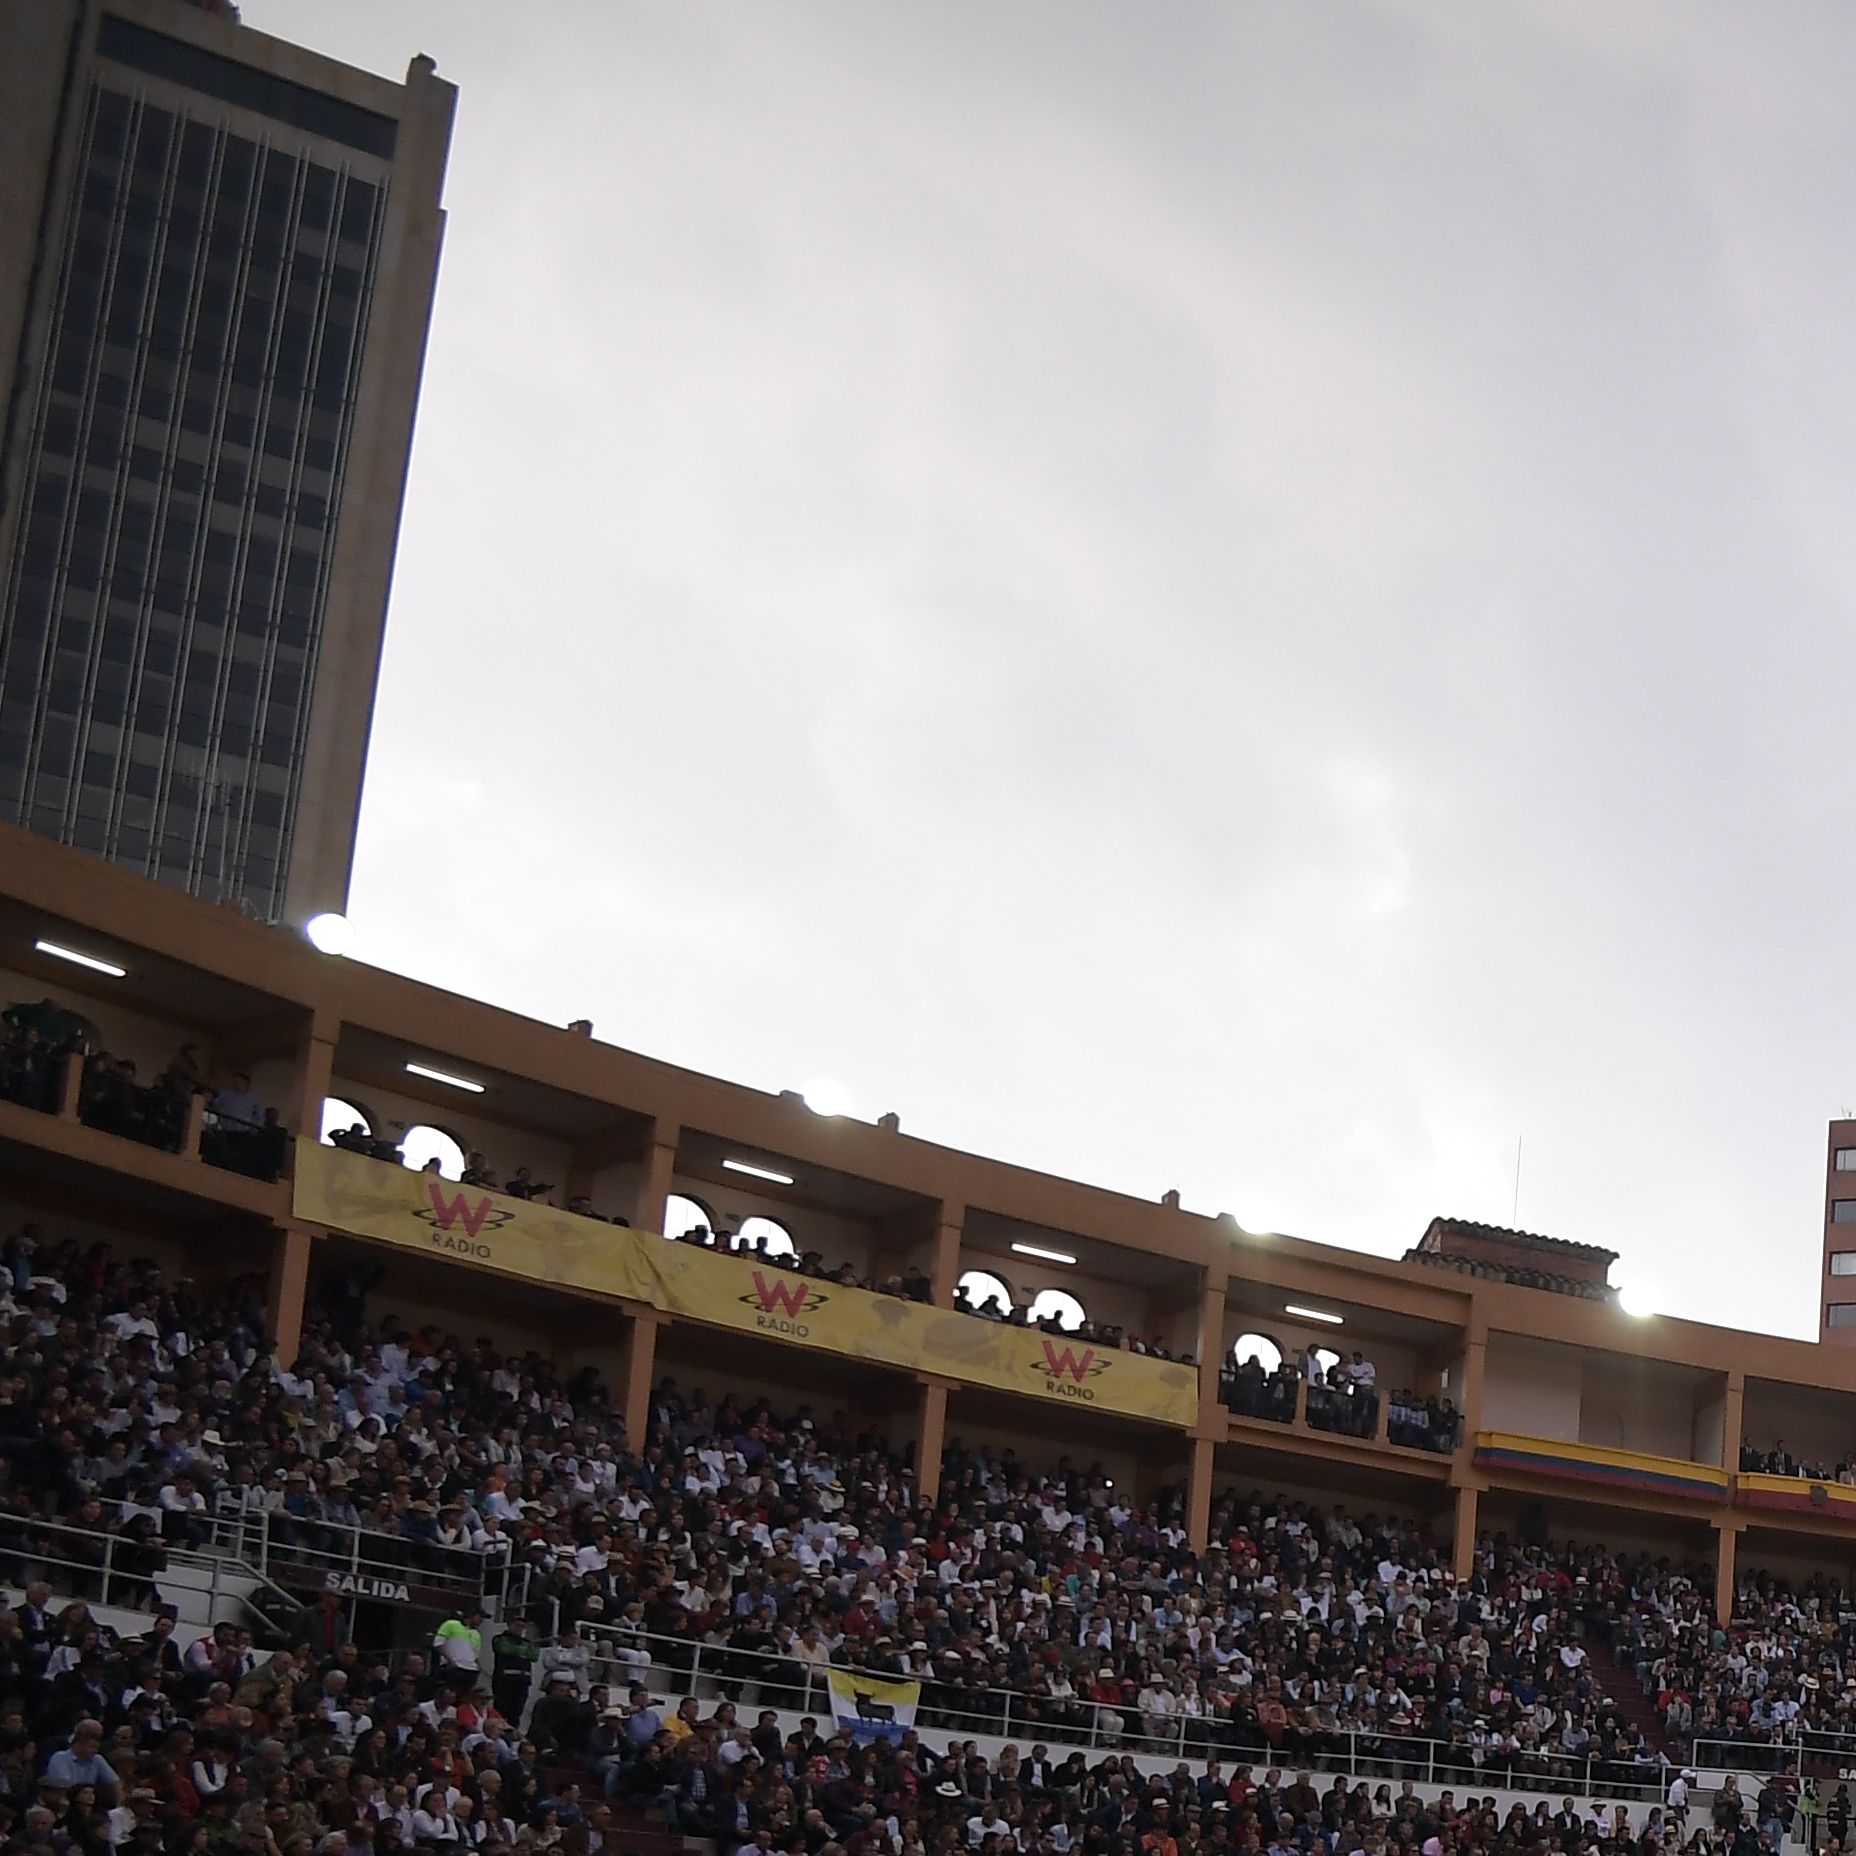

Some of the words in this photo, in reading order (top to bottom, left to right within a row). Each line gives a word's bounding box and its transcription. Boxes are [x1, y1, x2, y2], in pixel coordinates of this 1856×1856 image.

[432, 1232, 490, 1258] RADIO
[757, 1315, 809, 1338] RADIO
[1046, 1381, 1094, 1401] RADIO
[326, 1572, 410, 1602] SALIDA
